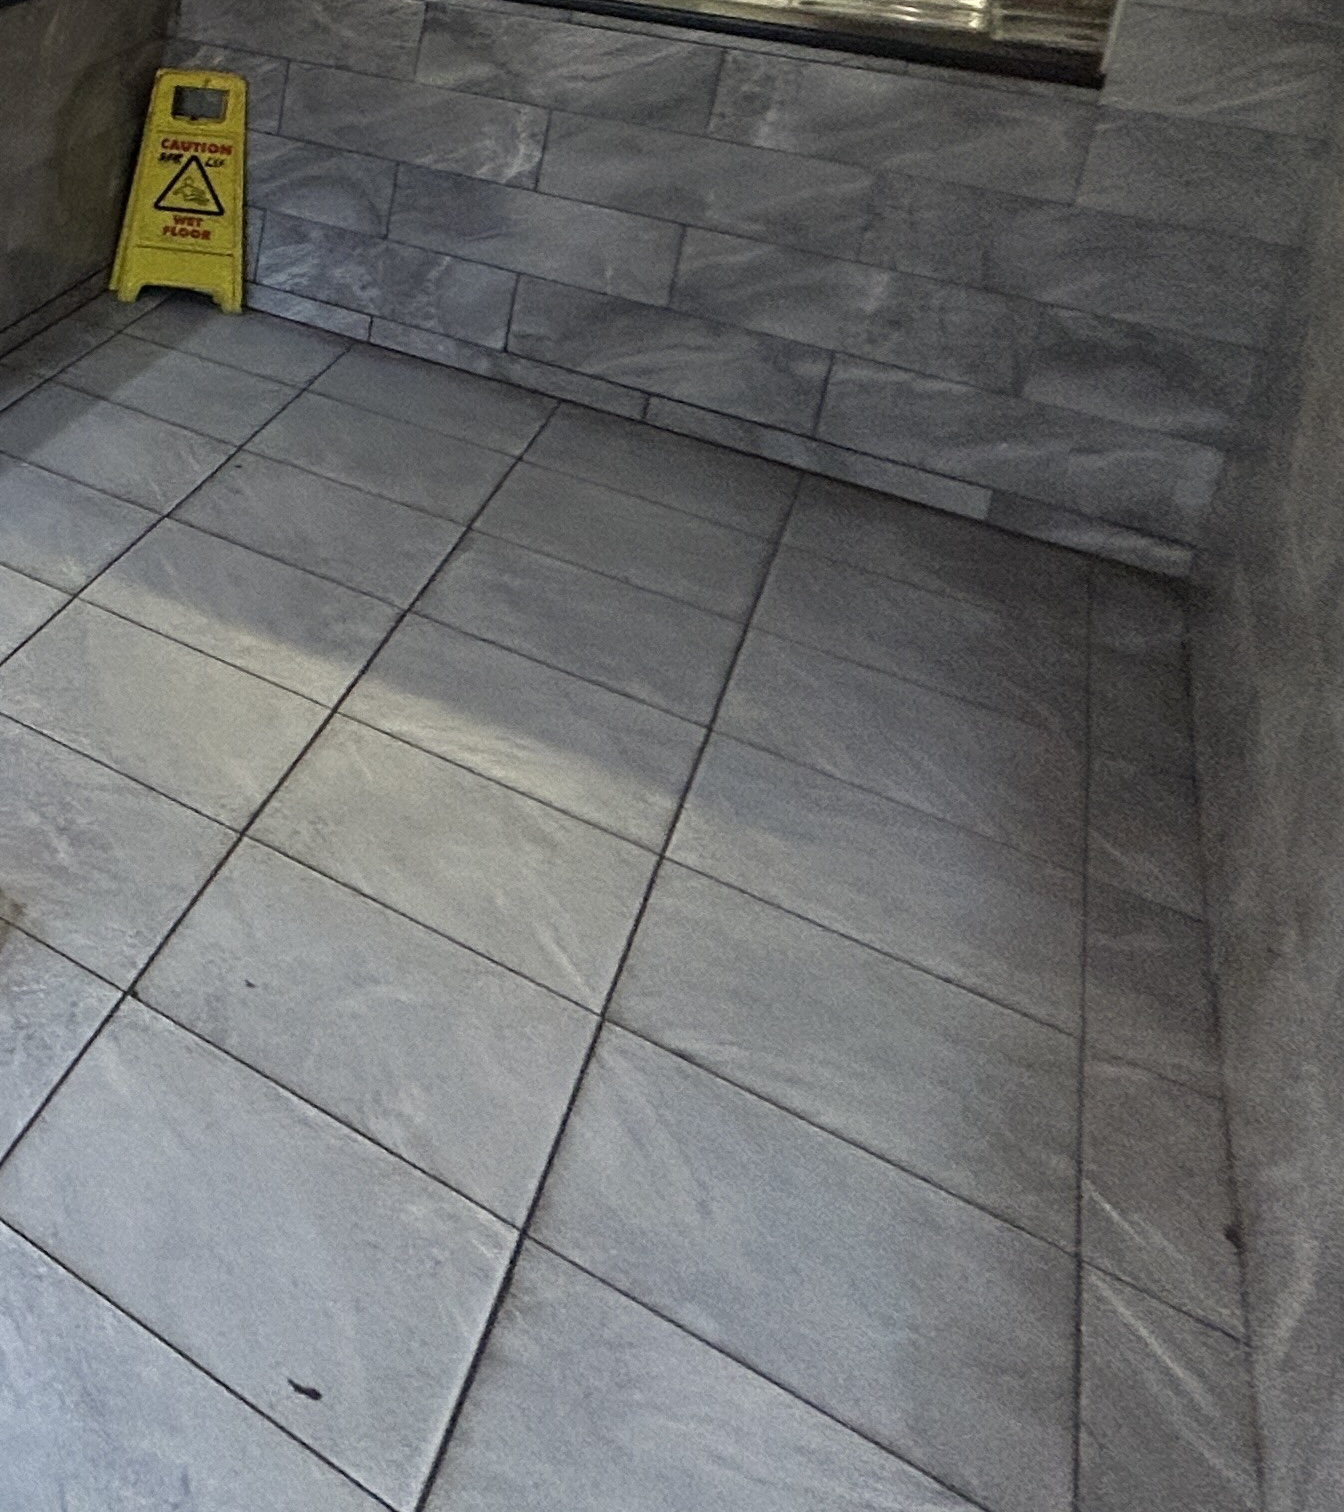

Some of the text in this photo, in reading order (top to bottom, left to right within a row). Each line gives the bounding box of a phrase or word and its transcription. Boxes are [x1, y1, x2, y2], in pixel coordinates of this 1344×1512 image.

[161, 138, 232, 155] CAUTION
[172, 215, 203, 227] WET
[163, 226, 211, 241] FLOOR
